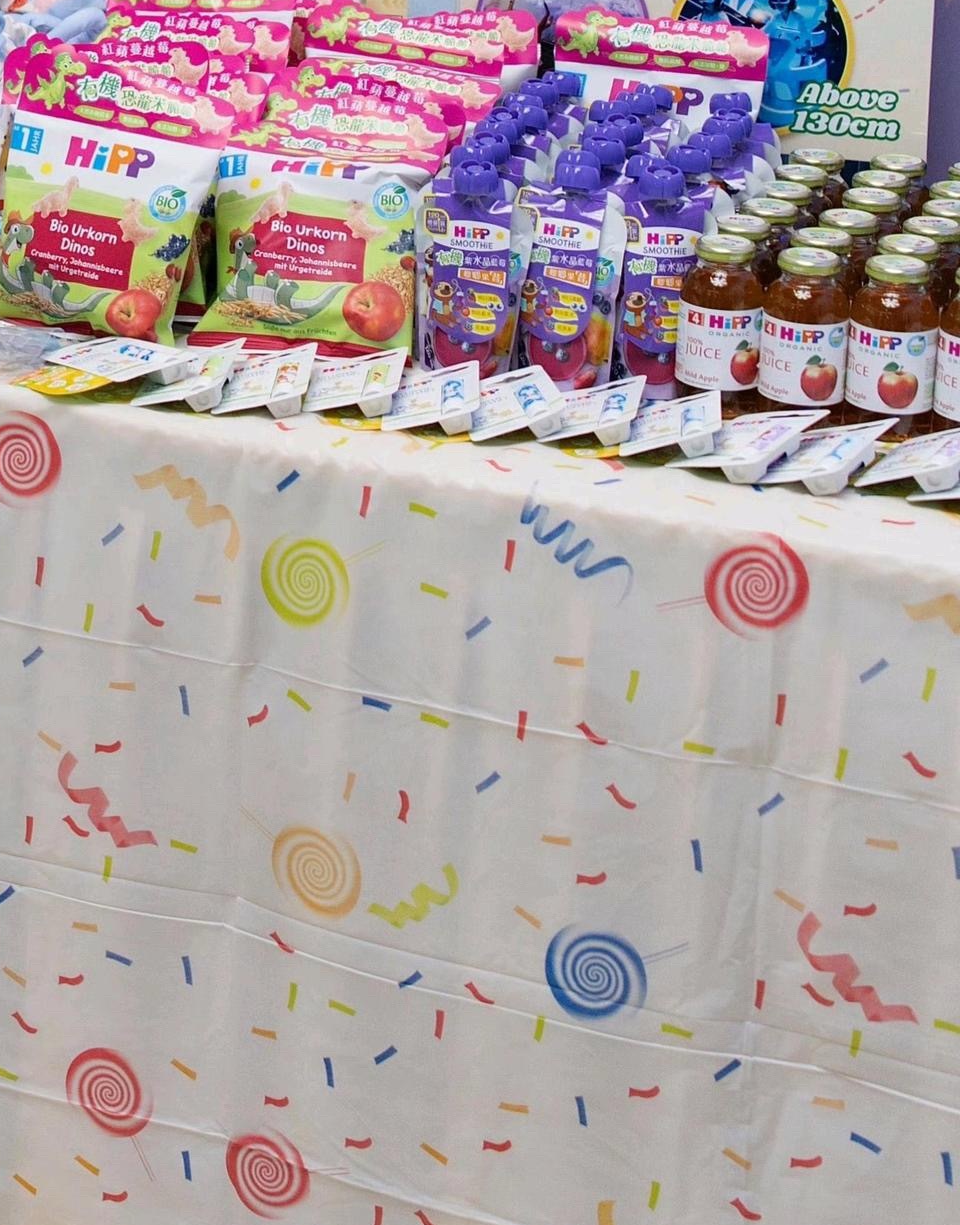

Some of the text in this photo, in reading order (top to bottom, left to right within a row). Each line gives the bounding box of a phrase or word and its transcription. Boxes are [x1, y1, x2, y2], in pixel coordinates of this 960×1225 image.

[79, 72, 121, 100] 有機
[797, 80, 899, 112] Above
[790, 109, 901, 140] 130cm
[20, 126, 31, 151] 1
[65, 135, 156, 178] HiPP
[225, 156, 235, 176] 1
[155, 194, 179, 211] BIO
[381, 193, 403, 208] BIO
[49, 218, 118, 245] Bio Urkorn
[271, 220, 348, 242] Bio Urkorn
[454, 226, 490, 239] HiPP
[544, 223, 581, 238] HiPP
[647, 233, 685, 246] HiPP
[60, 237, 96, 257] Dinos
[286, 237, 326, 255] Dinos
[30, 248, 124, 276] Cranberry, Johannisbeere
[253, 249, 358, 271] Cranberry, Johannisbeere
[274, 262, 334, 277] mit Urgetreide
[48, 262, 100, 281] mit Urgetreide
[709, 314, 751, 329] HiPP
[780, 326, 825, 344] HiPP
[859, 330, 902, 350] HiPP
[685, 343, 722, 360] JUICE
[699, 373, 719, 383] Apple
